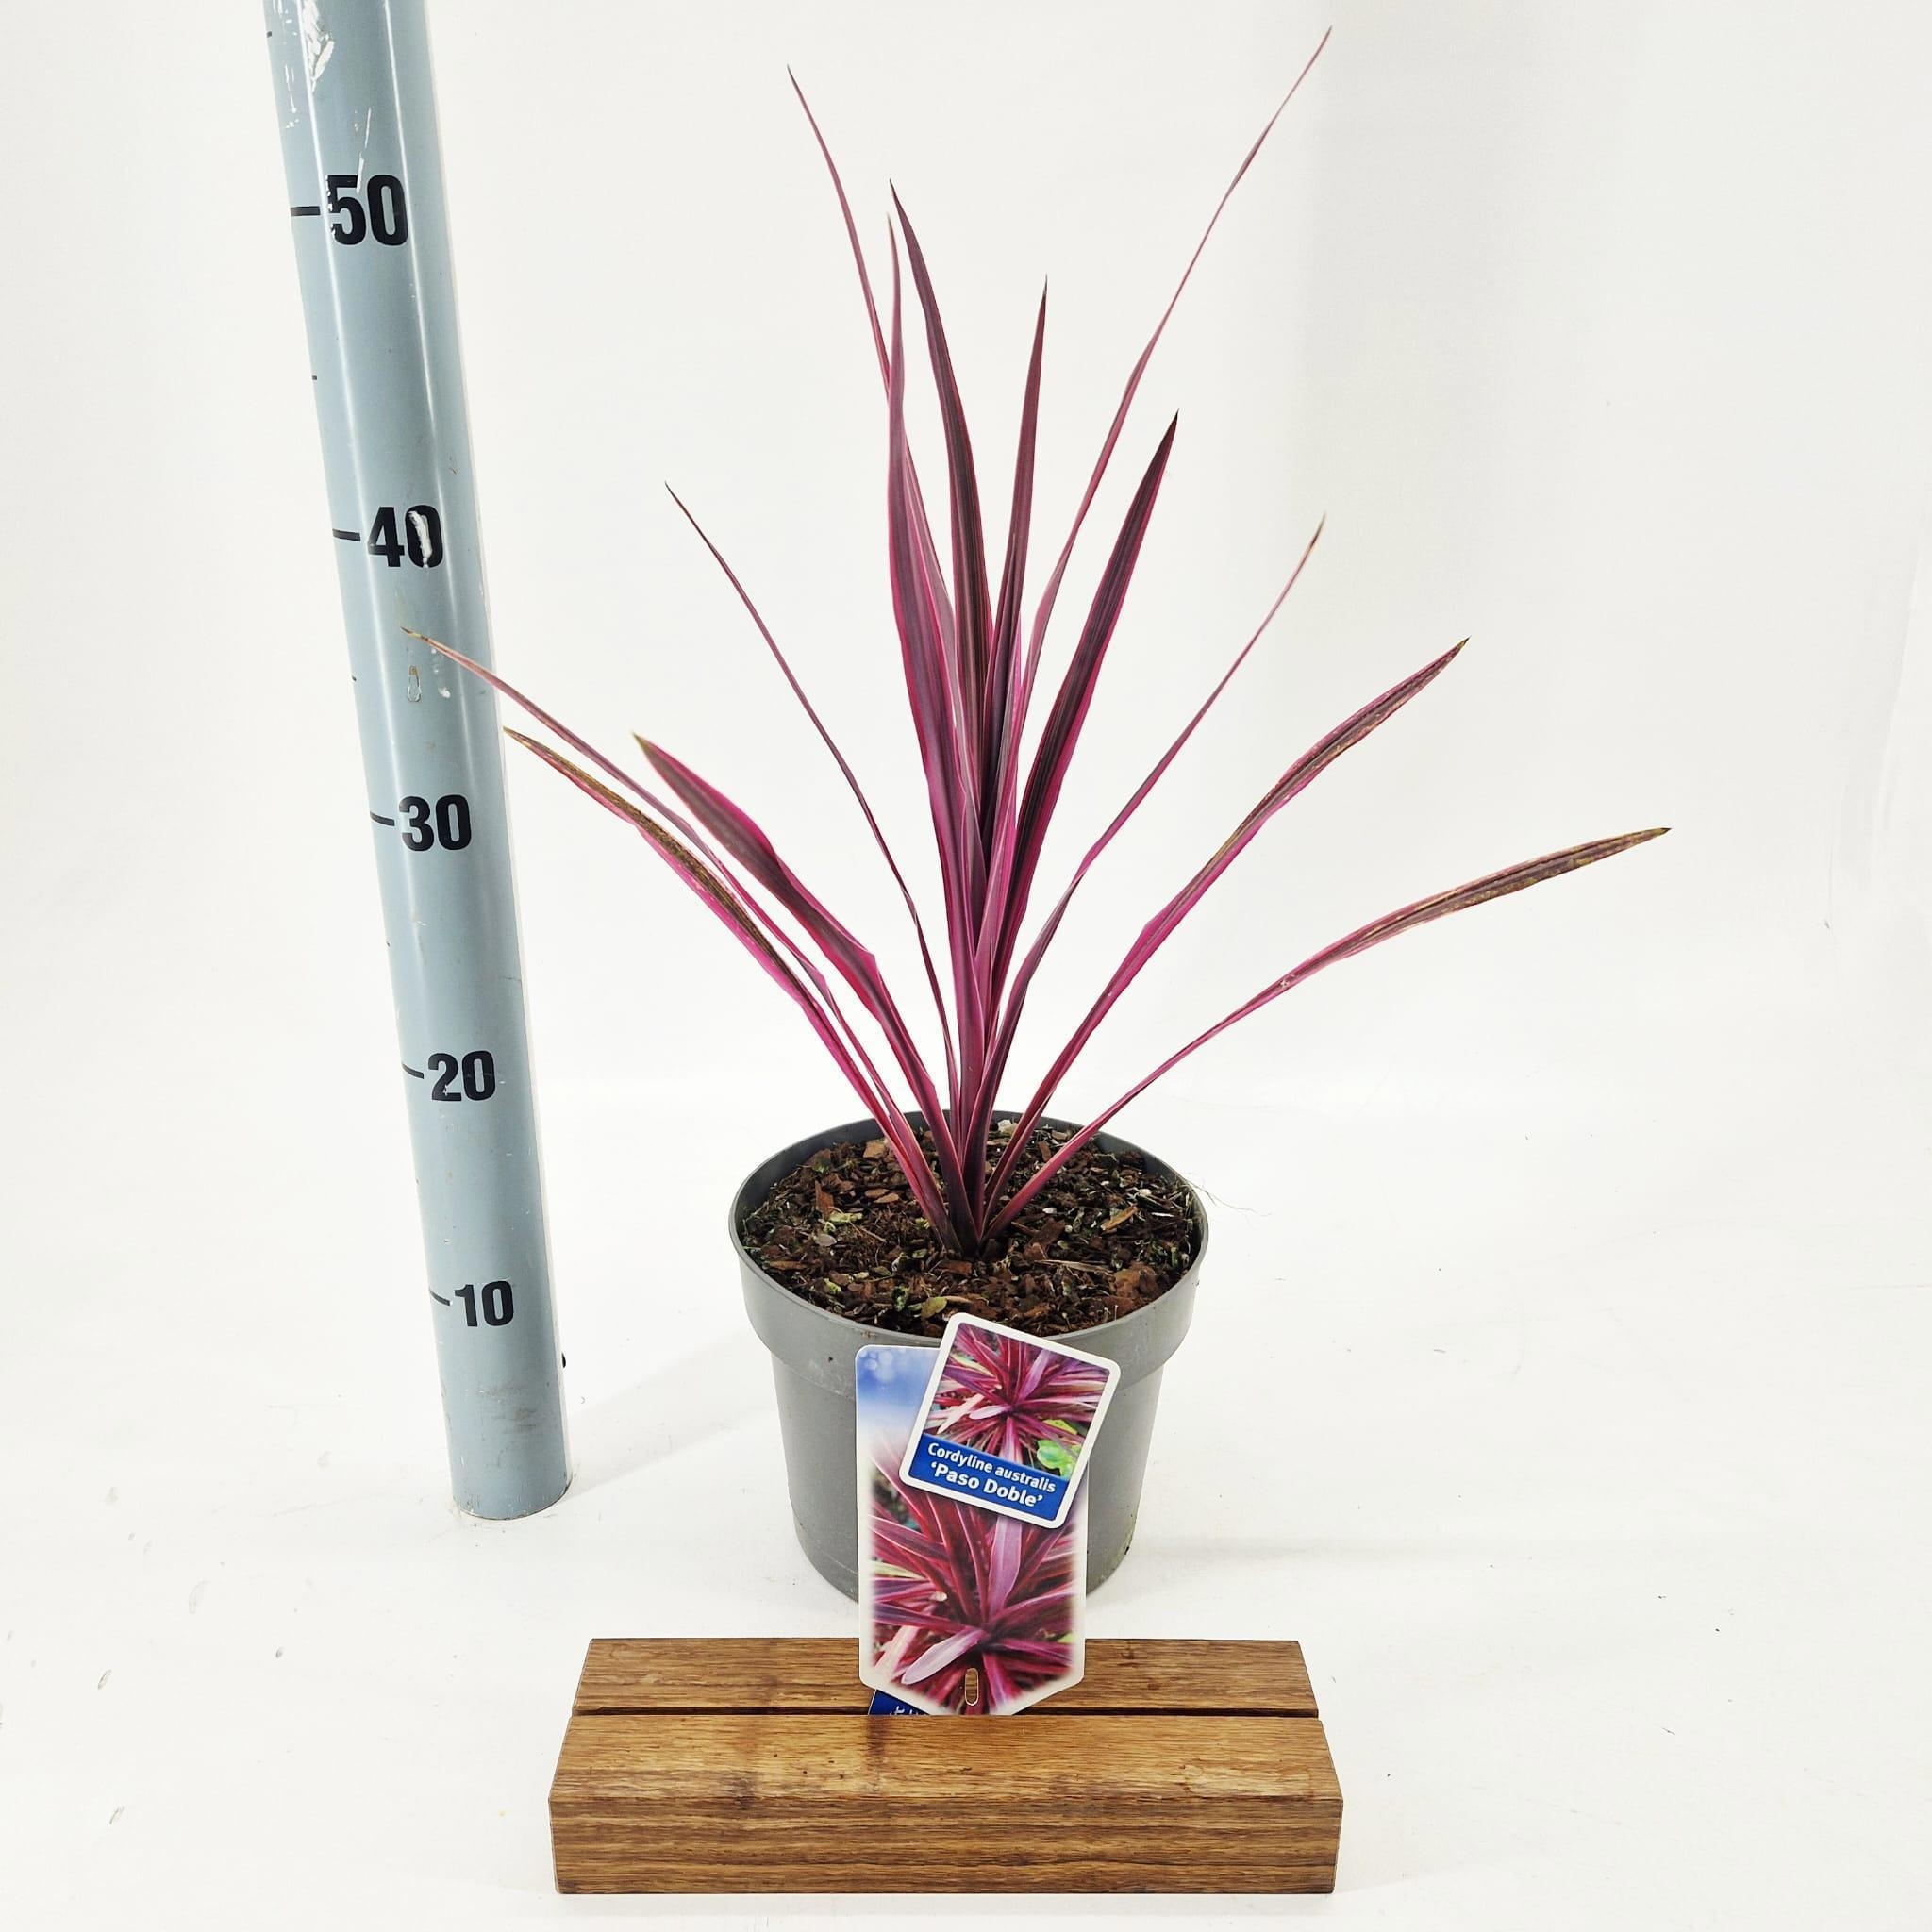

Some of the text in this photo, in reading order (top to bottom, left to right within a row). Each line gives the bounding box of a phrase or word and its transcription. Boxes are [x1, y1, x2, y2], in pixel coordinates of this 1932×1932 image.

[325, 174, 409, 246] 50
[368, 504, 444, 569] 40
[399, 794, 472, 852] 30
[427, 1050, 496, 1102] 20
[454, 1280, 514, 1327] 10
[927, 1442, 1057, 1493] Cordyline australis
[930, 1461, 1043, 1507] ‘Paso Doble’
